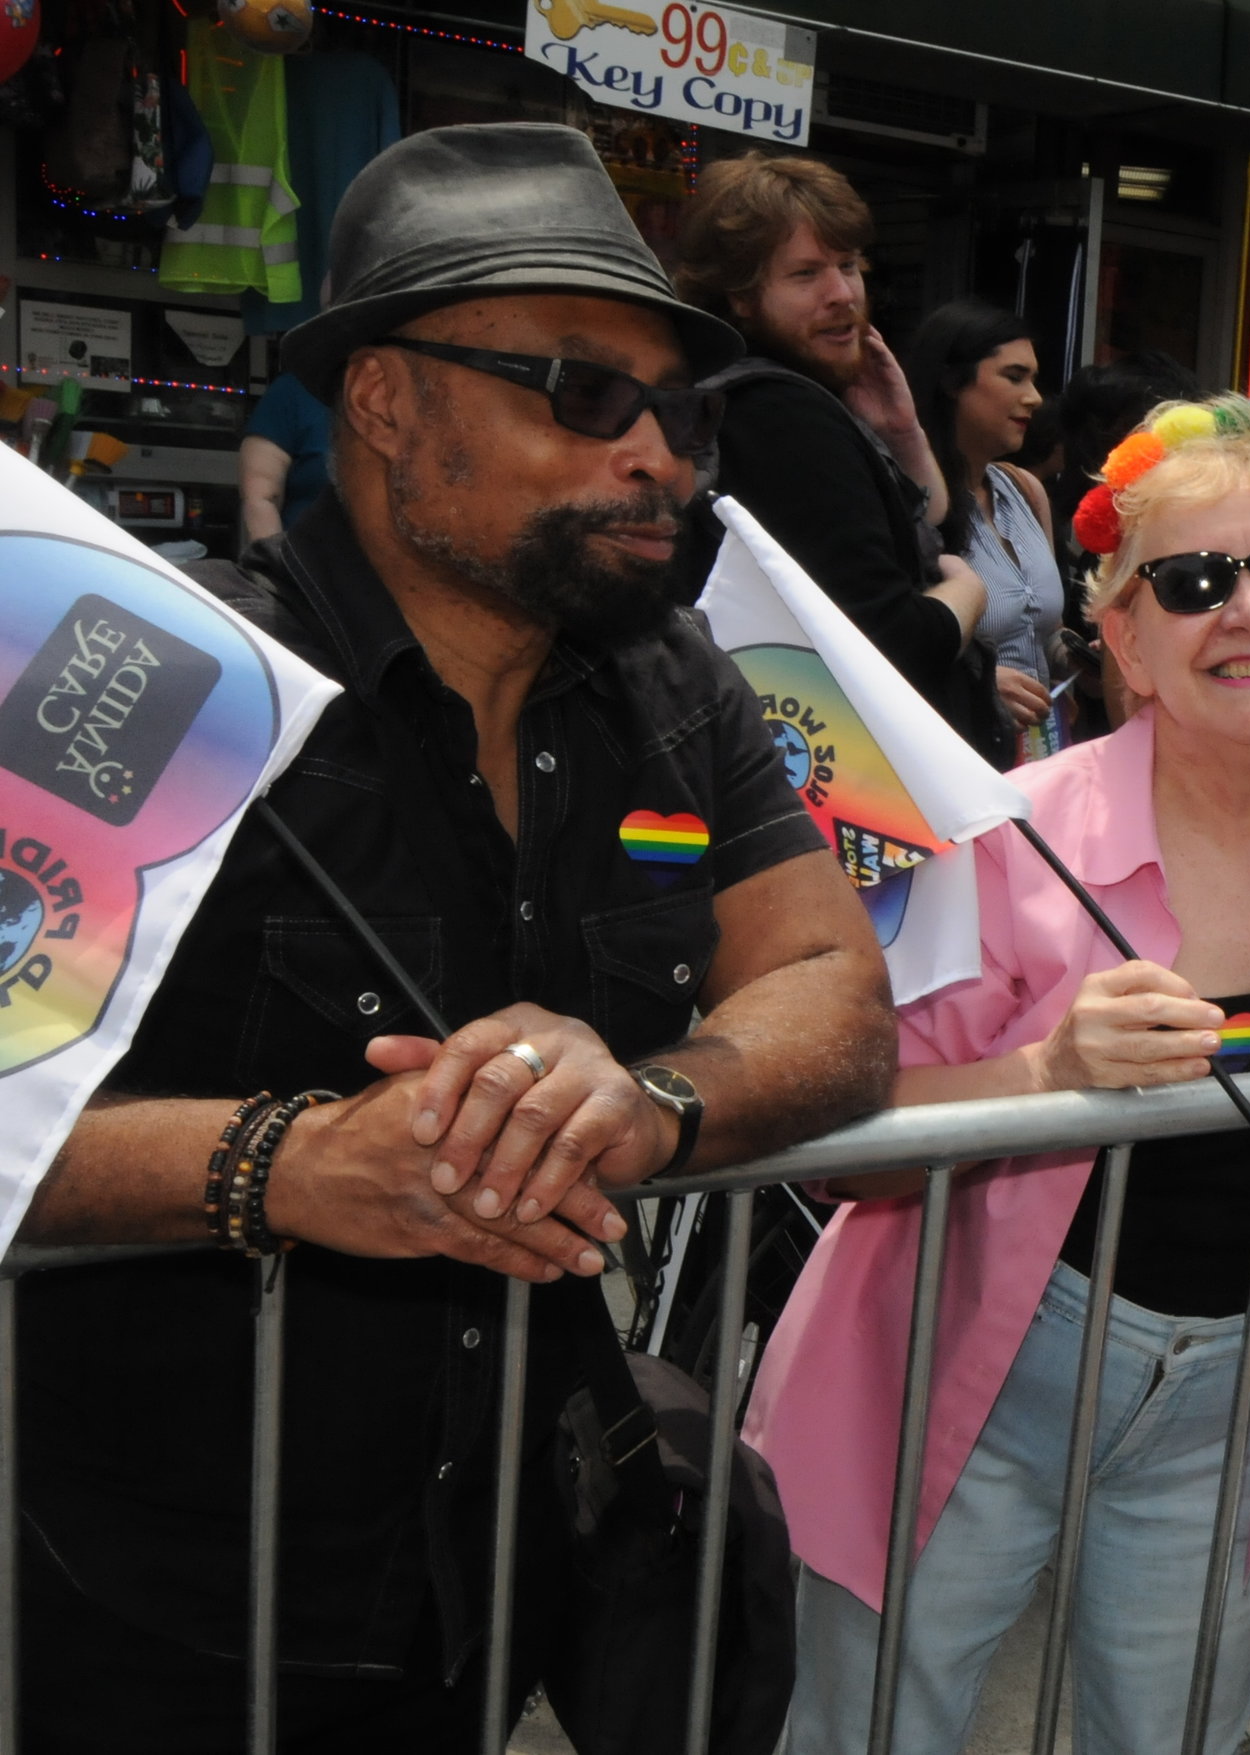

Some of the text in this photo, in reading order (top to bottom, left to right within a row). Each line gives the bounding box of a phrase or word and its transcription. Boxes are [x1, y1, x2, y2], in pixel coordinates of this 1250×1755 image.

[541, 43, 803, 140] Key Copy
[752, 49, 770, 78] &
